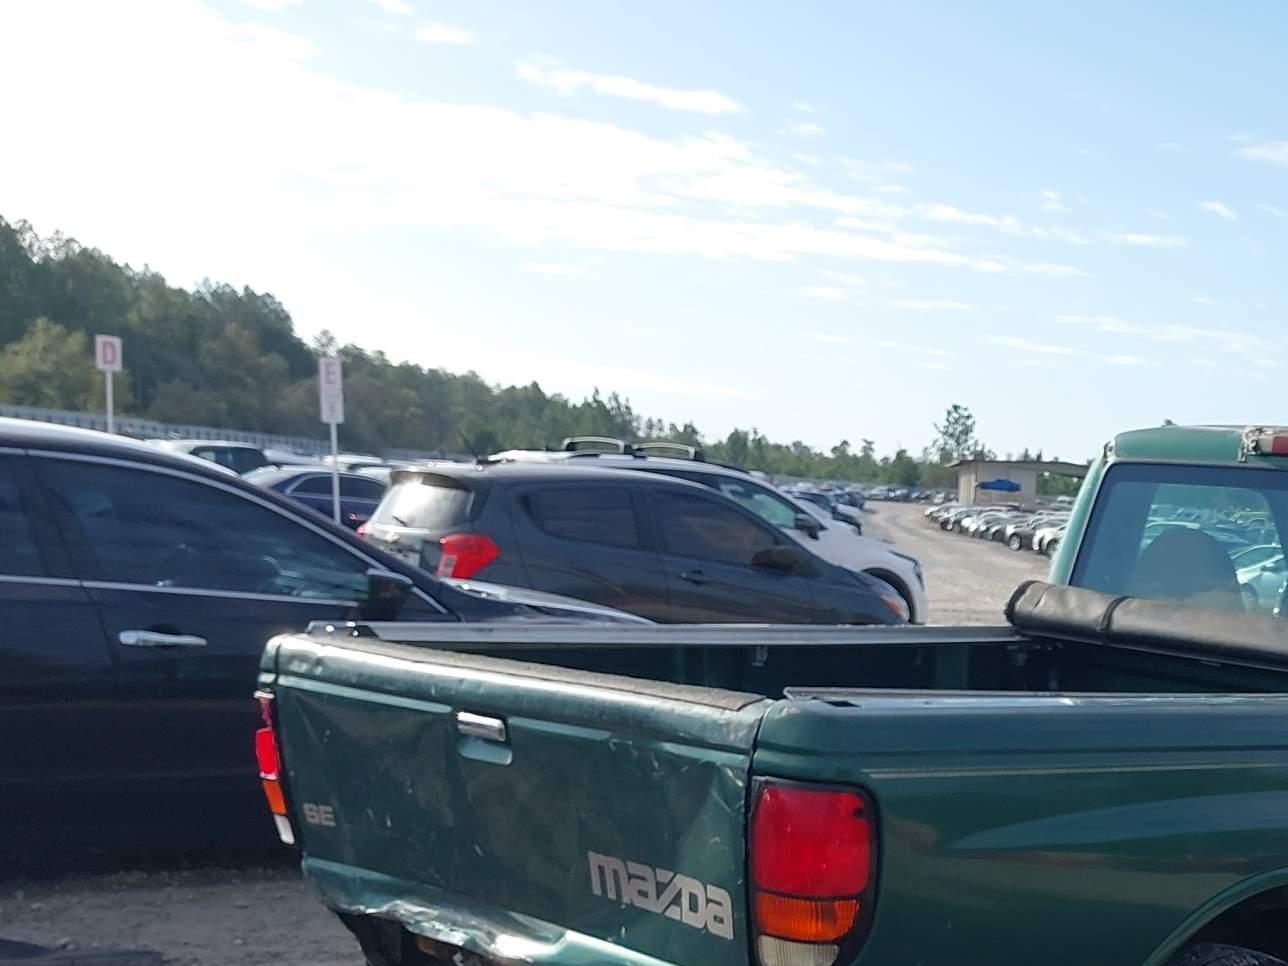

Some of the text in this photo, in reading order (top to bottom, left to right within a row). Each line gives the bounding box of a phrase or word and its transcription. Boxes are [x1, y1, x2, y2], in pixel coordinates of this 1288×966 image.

[102, 340, 117, 365] D
[325, 362, 337, 384] E
[303, 803, 336, 827] SE
